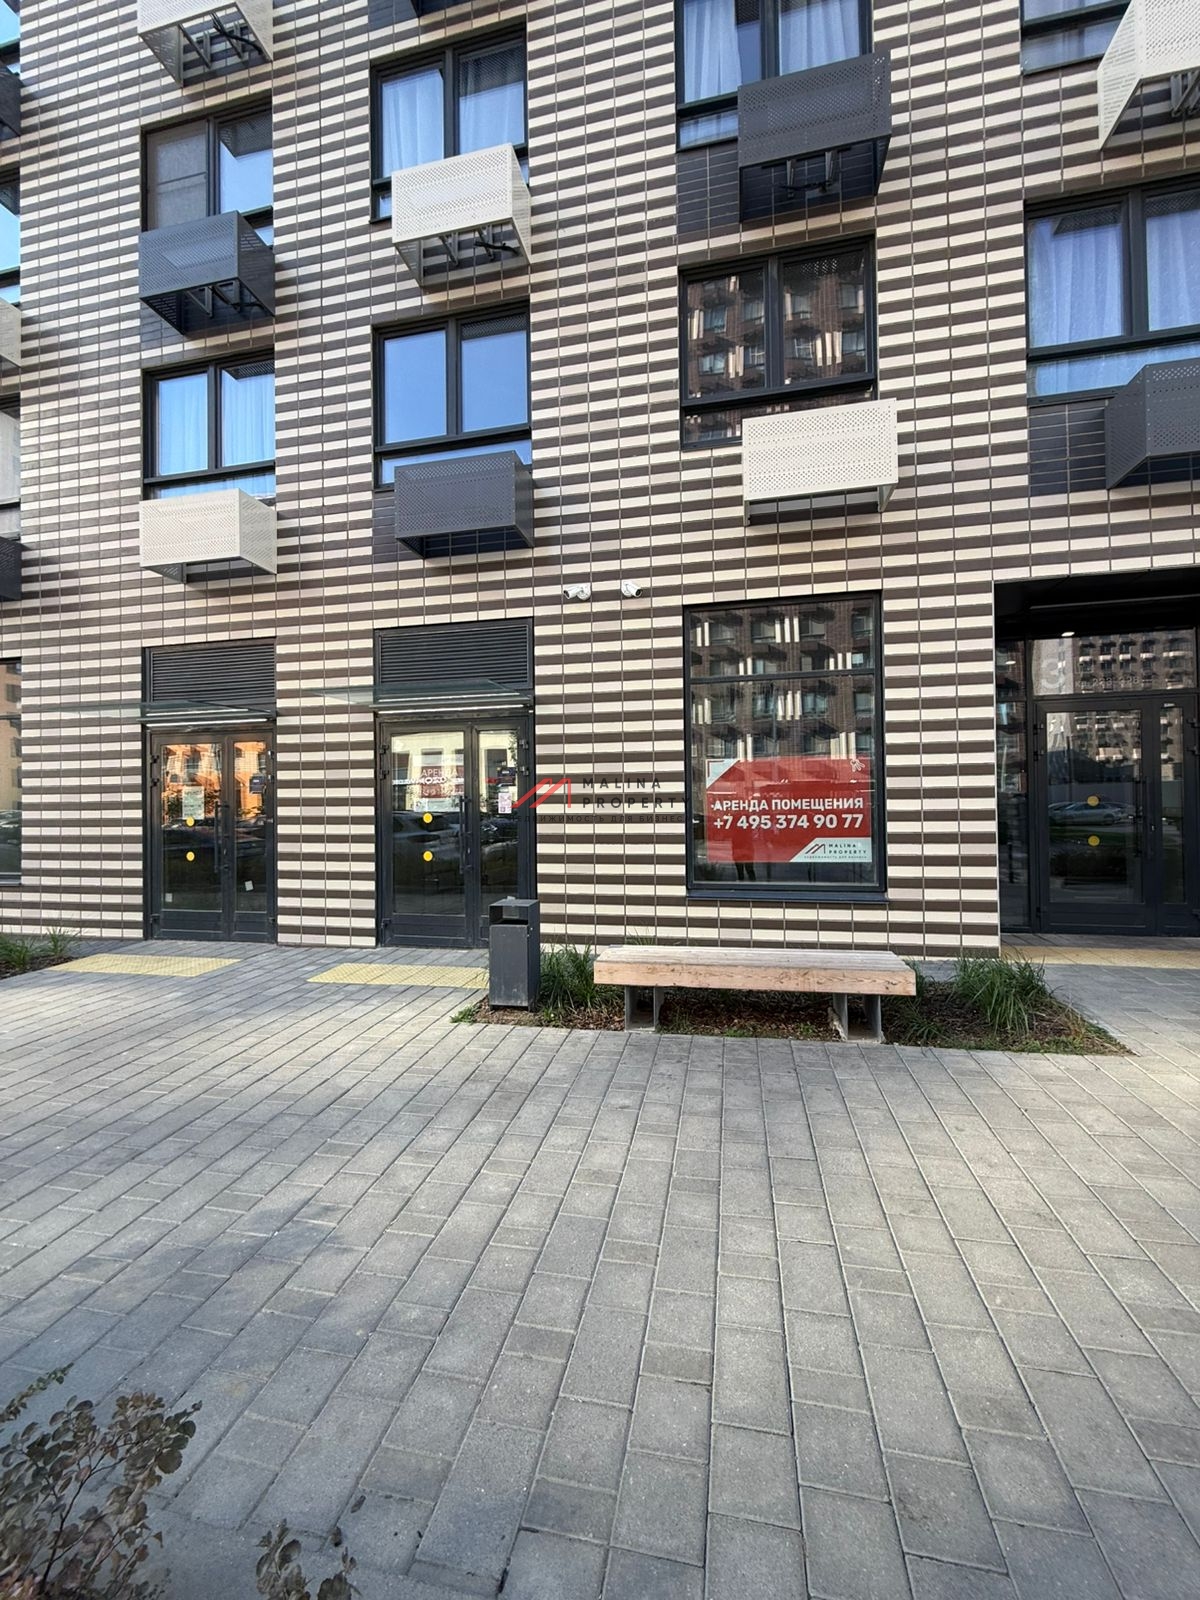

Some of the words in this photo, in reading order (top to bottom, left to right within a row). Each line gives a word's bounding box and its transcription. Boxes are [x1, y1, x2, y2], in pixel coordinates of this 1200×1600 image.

[712, 799, 769, 812] АРЕНДА
[771, 797, 864, 811] ПОМЕЩЕНИЯ
[713, 815, 734, 830] +7
[736, 815, 771, 829] 495
[775, 815, 810, 829] 374
[813, 814, 838, 829] 90
[842, 813, 864, 829] 77
